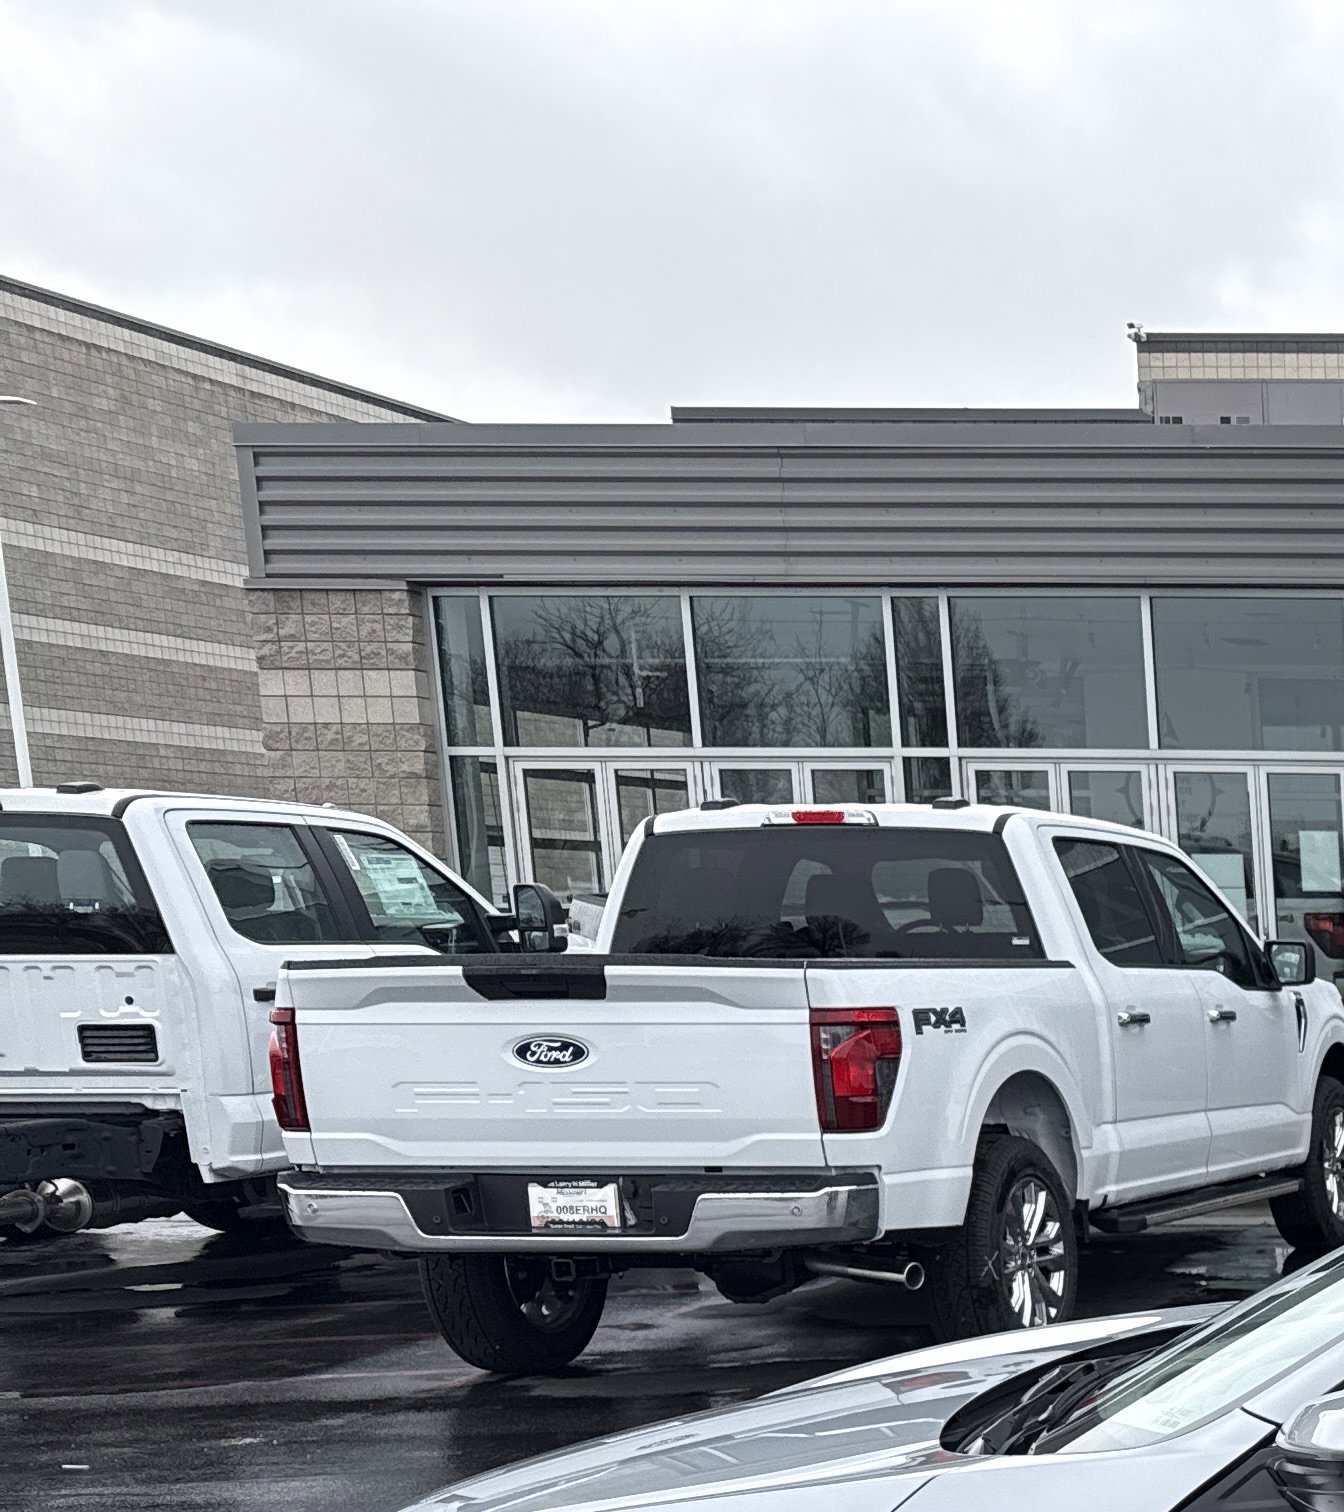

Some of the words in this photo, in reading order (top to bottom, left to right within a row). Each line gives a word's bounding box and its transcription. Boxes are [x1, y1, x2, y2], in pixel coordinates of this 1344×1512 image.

[911, 1007, 966, 1036] FX4
[526, 1039, 574, 1063] Ford
[555, 1204, 608, 1215] 008ERHQ
